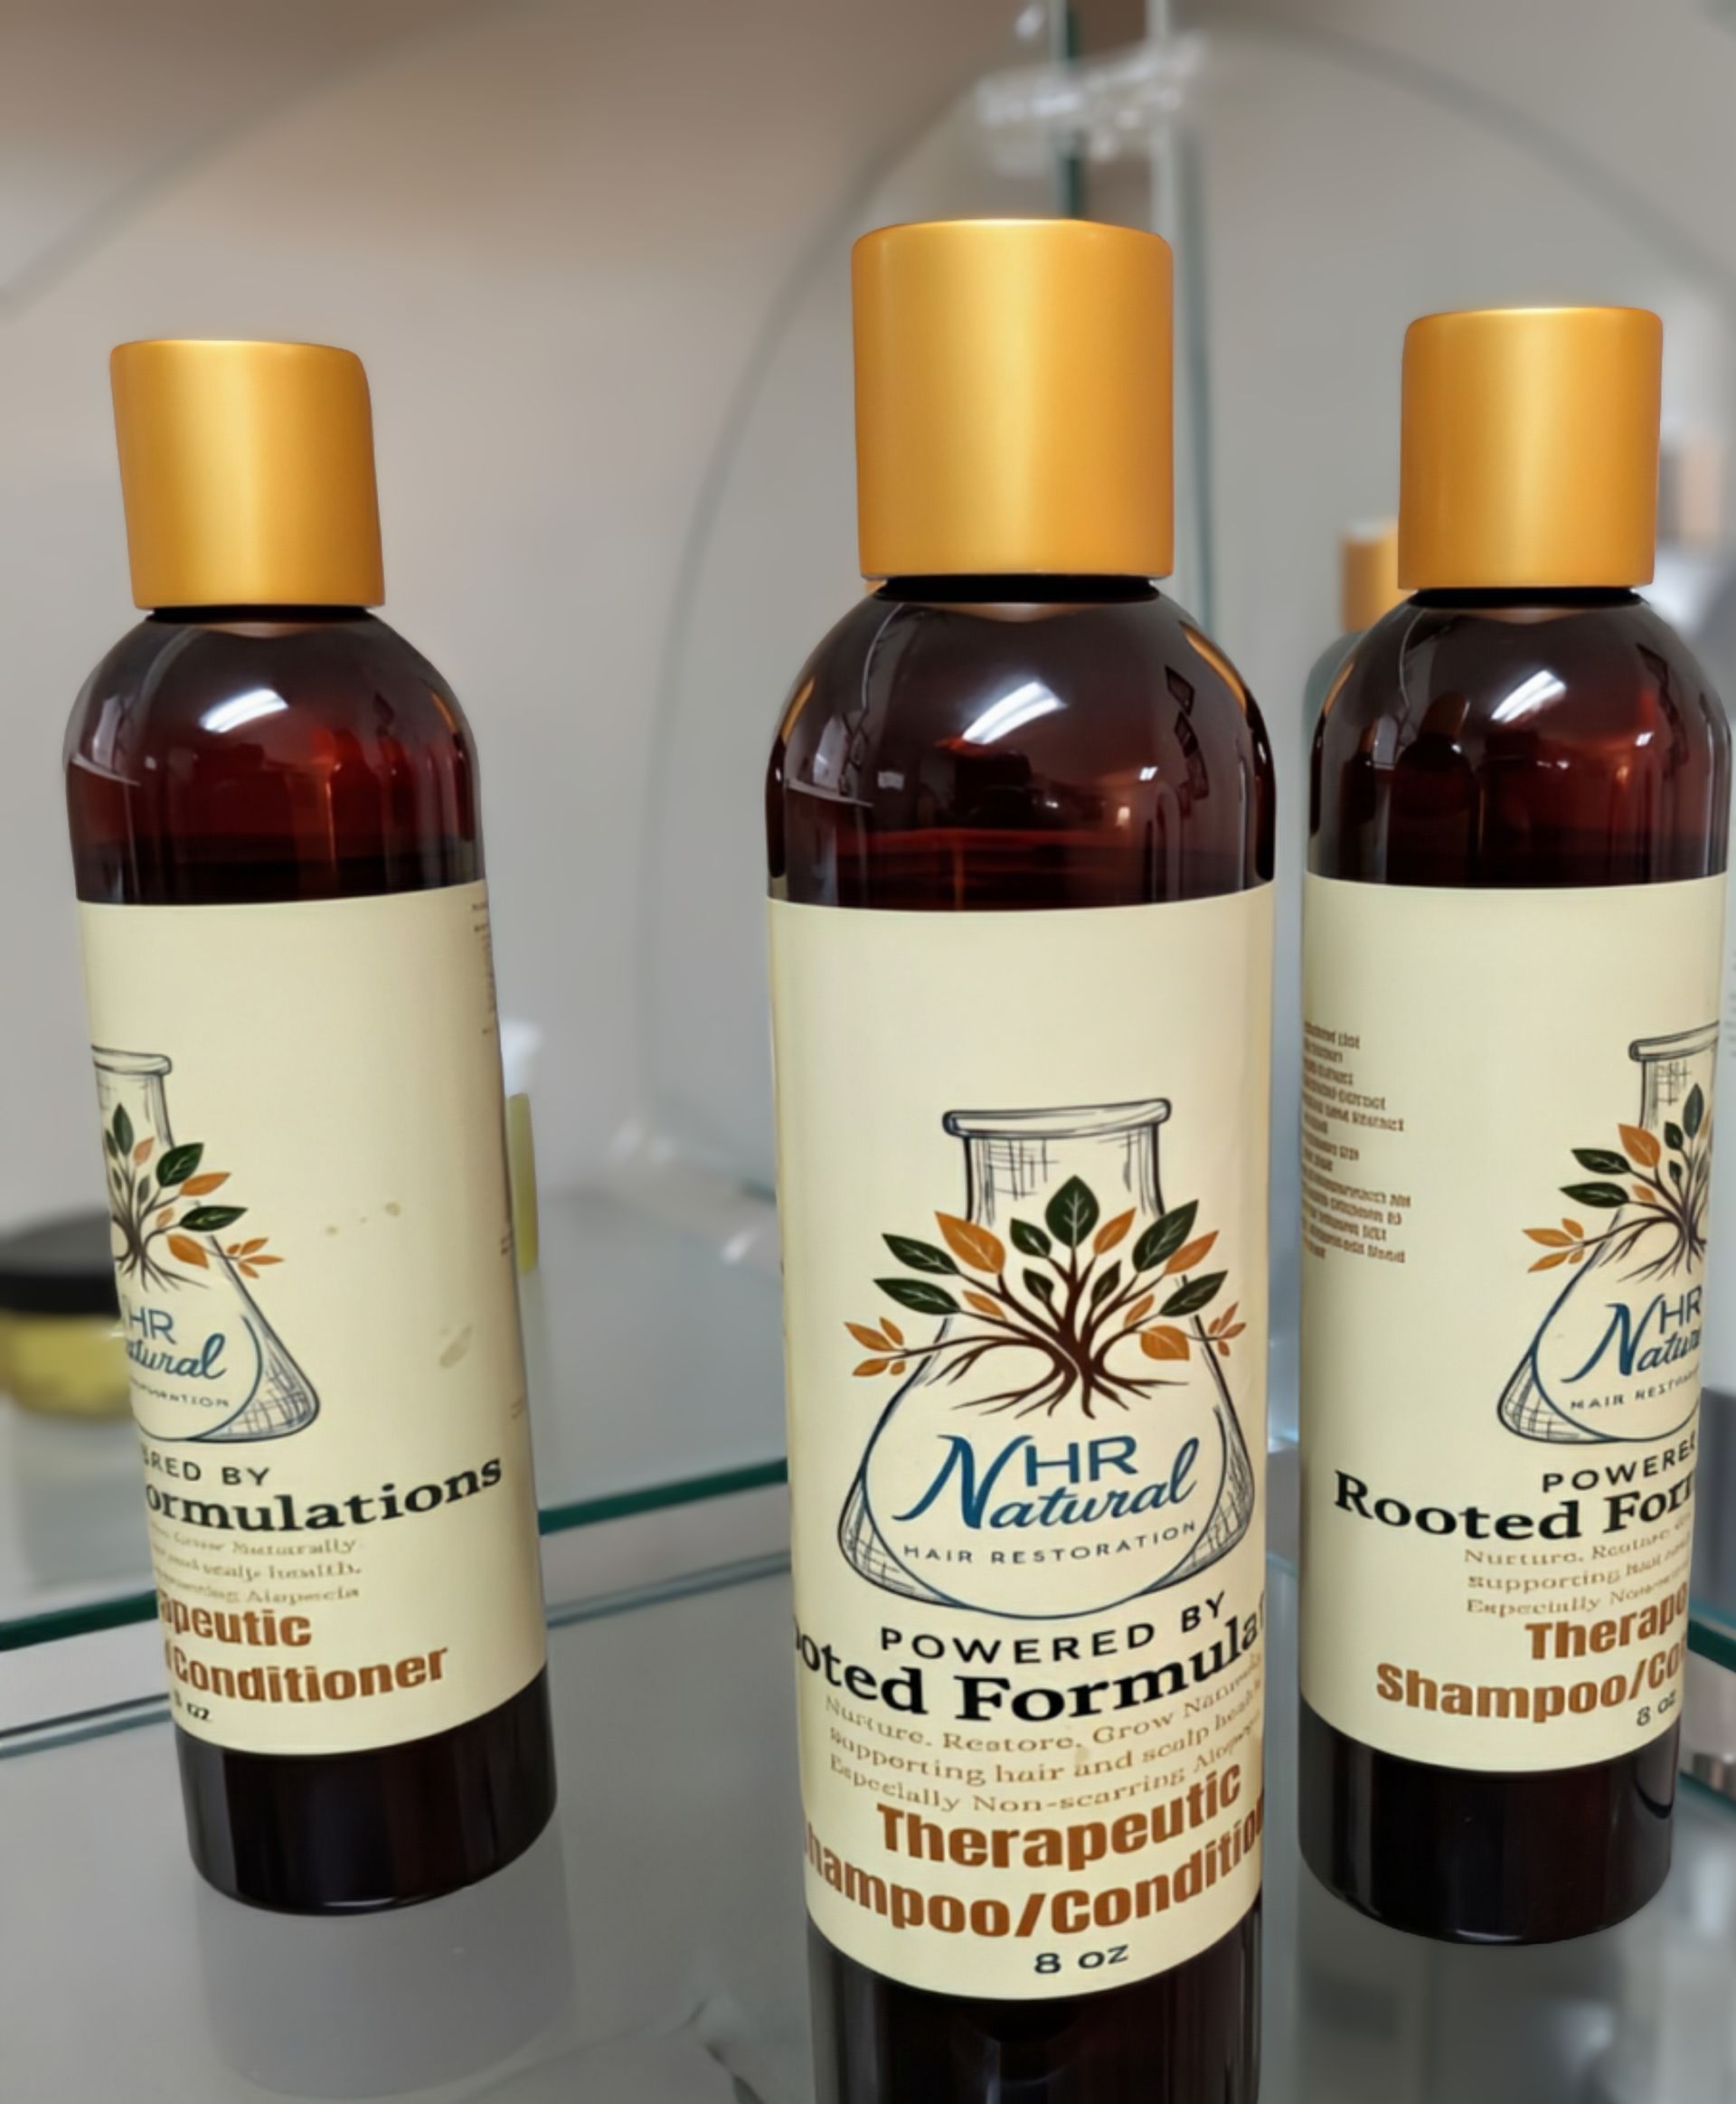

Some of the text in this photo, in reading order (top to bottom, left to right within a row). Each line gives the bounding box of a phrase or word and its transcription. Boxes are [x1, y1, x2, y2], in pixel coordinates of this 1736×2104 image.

[222, 1466, 270, 1486] BY
[1543, 1431, 1695, 1493] POWERE
[1335, 1469, 1581, 1541] Rooted
[902, 1522, 1197, 1565] HAIR RESTORATION
[880, 1590, 1226, 1665] POWERED BY
[1092, 1712, 1175, 1745] Grow
[995, 1761, 1065, 1783] hair
[1073, 1741, 1133, 1778] and
[876, 1763, 1241, 1872] Therapeutic
[804, 1795, 1264, 1938] hampoo/Conditio
[1033, 1944, 1129, 1975] 8 oz
